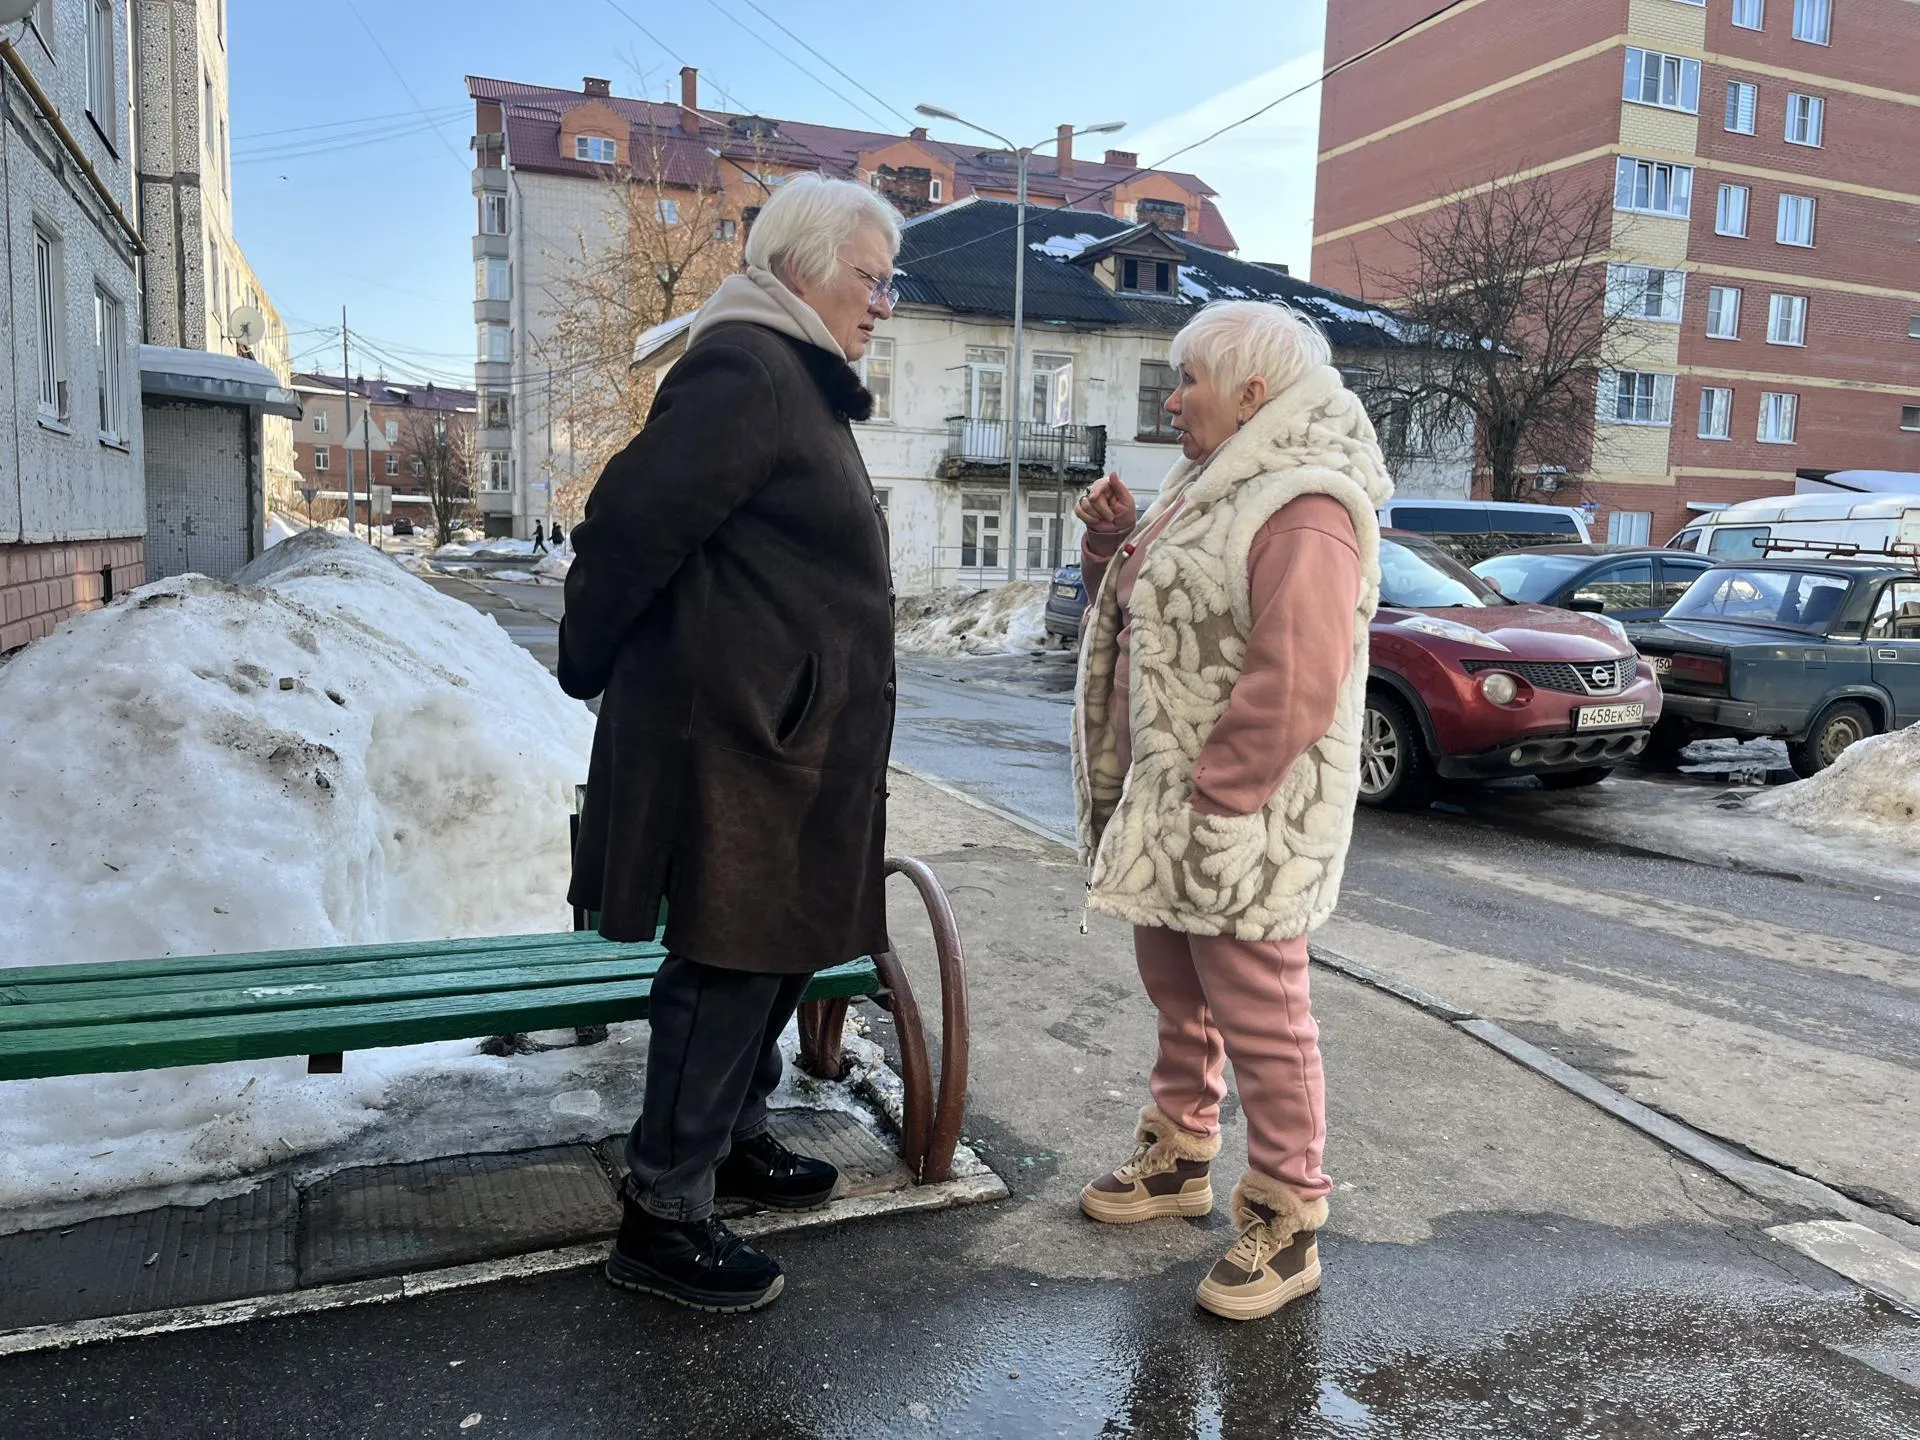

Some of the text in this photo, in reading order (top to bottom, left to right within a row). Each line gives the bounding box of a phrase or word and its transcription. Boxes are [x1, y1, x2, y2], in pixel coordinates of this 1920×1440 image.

[1057, 374, 1068, 420] P
[1654, 657, 1670, 670] 150
[1625, 705, 1642, 719] 550
